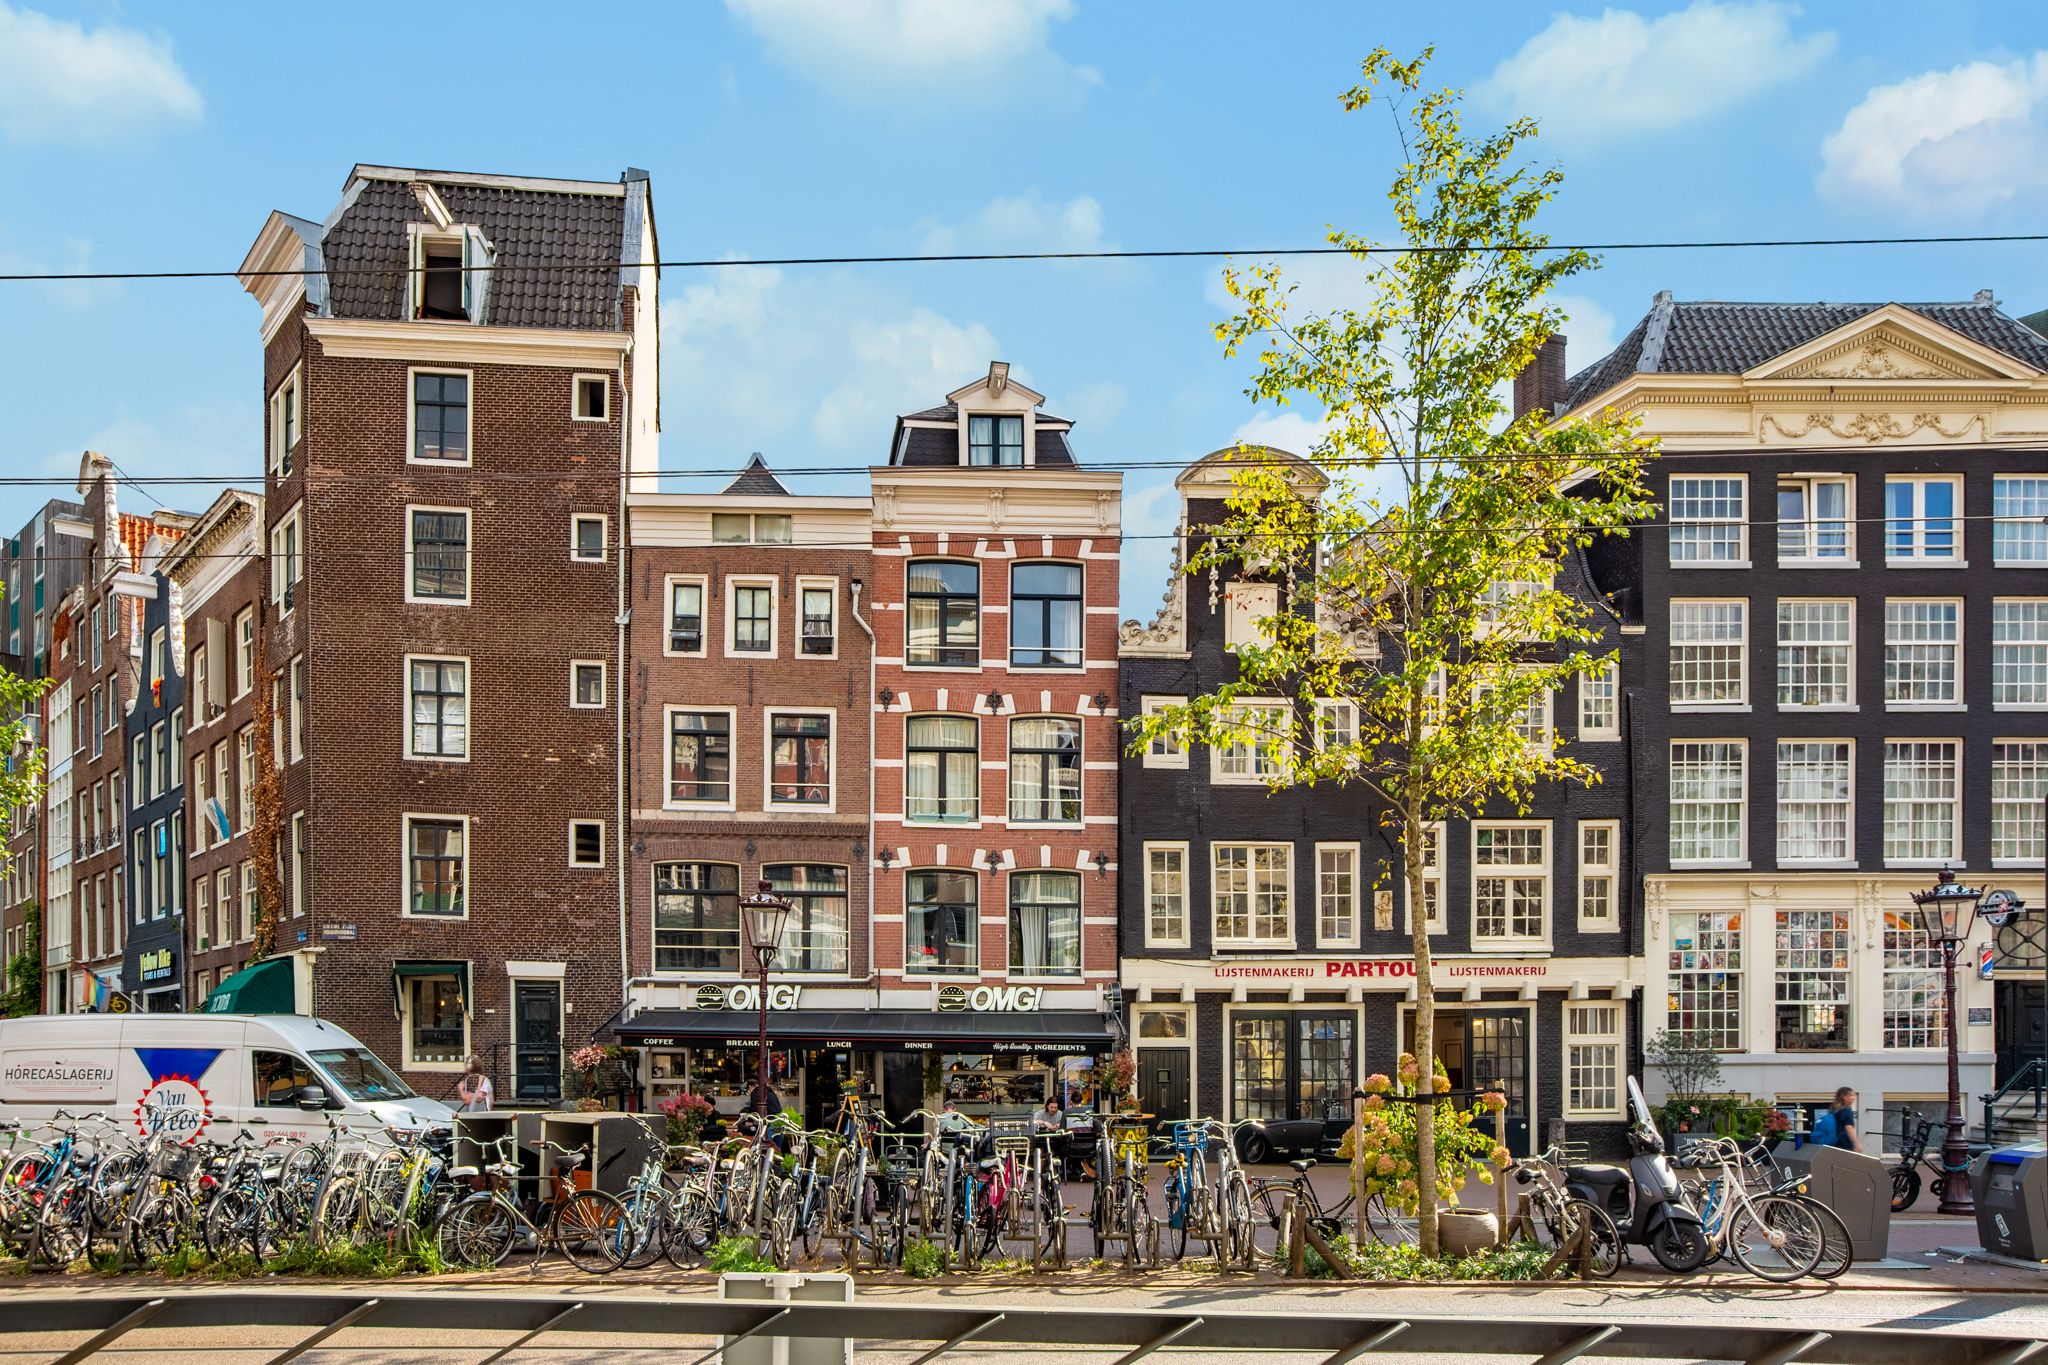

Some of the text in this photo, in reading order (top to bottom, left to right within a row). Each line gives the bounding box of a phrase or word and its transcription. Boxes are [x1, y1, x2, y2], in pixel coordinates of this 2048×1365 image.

[1215, 967, 1314, 978] LIJSTENMAKERIJ
[1326, 961, 1438, 977] PARTOU
[1450, 966, 1547, 976] LIJSTENMAKERIJ
[728, 984, 802, 1010] OMG!
[970, 986, 1043, 1012] OMG!
[643, 1038, 674, 1046] COFFEE
[726, 1039, 775, 1047] BREAKFST
[992, 1042, 1009, 1052] High
[1034, 1044, 1087, 1052] INGREDIENTS
[5, 1068, 114, 1080] HORECASLAGERIJ
[156, 1089, 187, 1106] Van
